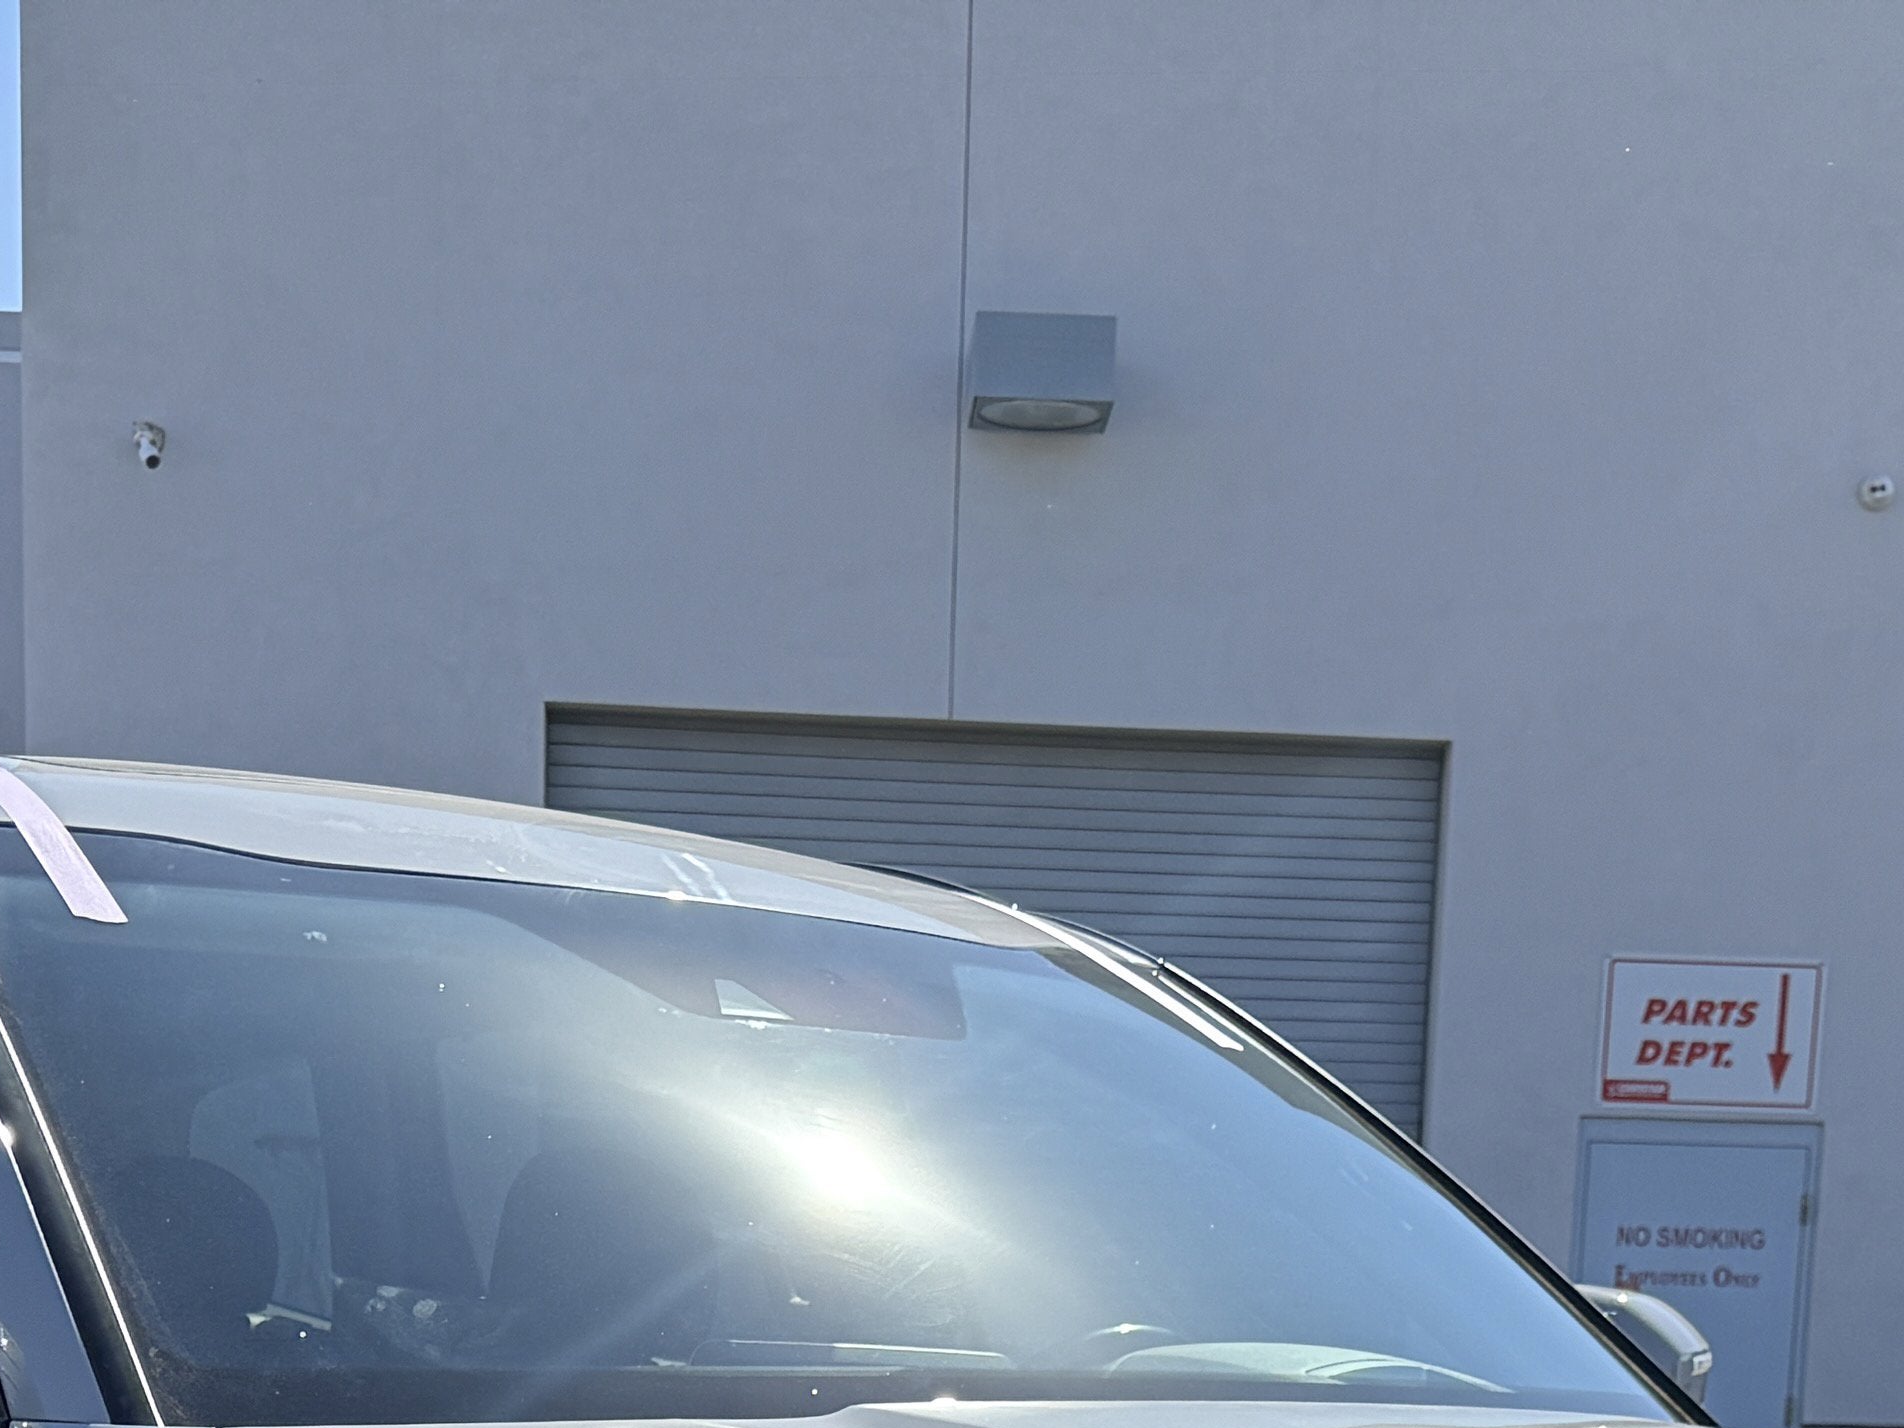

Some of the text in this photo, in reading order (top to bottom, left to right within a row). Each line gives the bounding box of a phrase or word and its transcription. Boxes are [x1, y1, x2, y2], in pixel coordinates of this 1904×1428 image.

[1641, 998, 1760, 1028] PARTS
[1635, 1040, 1733, 1069] DEPT.
[1616, 1225, 1766, 1250] NO SMOKING
